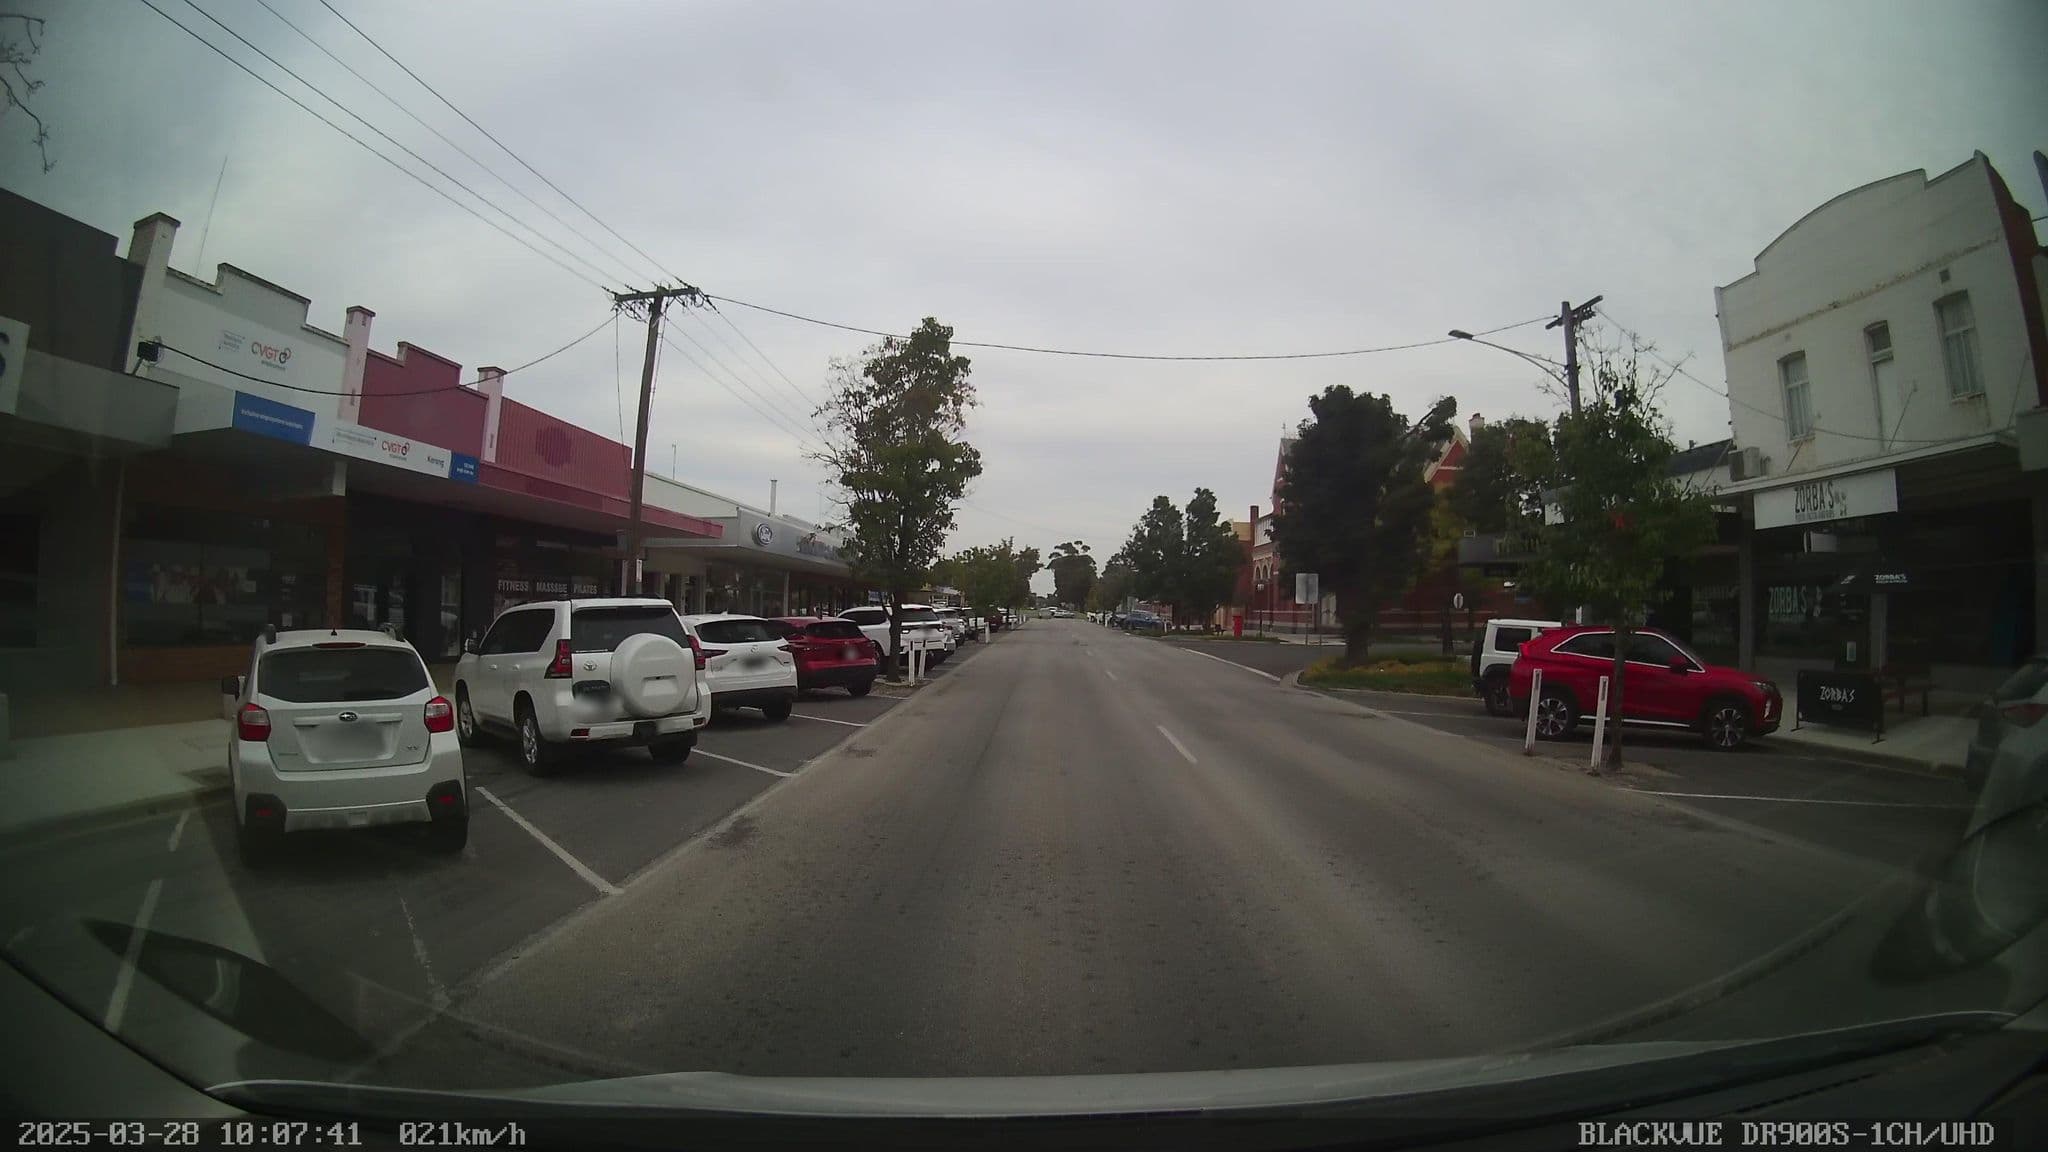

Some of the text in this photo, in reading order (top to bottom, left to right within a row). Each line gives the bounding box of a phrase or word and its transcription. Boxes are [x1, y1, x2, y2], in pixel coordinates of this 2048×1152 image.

[251, 341, 279, 361] CVGT
[382, 440, 402, 455] CVGT
[427, 455, 444, 468] Kerang
[1794, 481, 1835, 513] ZORBA'S
[498, 580, 529, 592] FITNESS
[573, 584, 598, 594] PILATES
[1768, 585, 1808, 614] ZORBA'S
[1819, 686, 1856, 703] ZORBA'S
